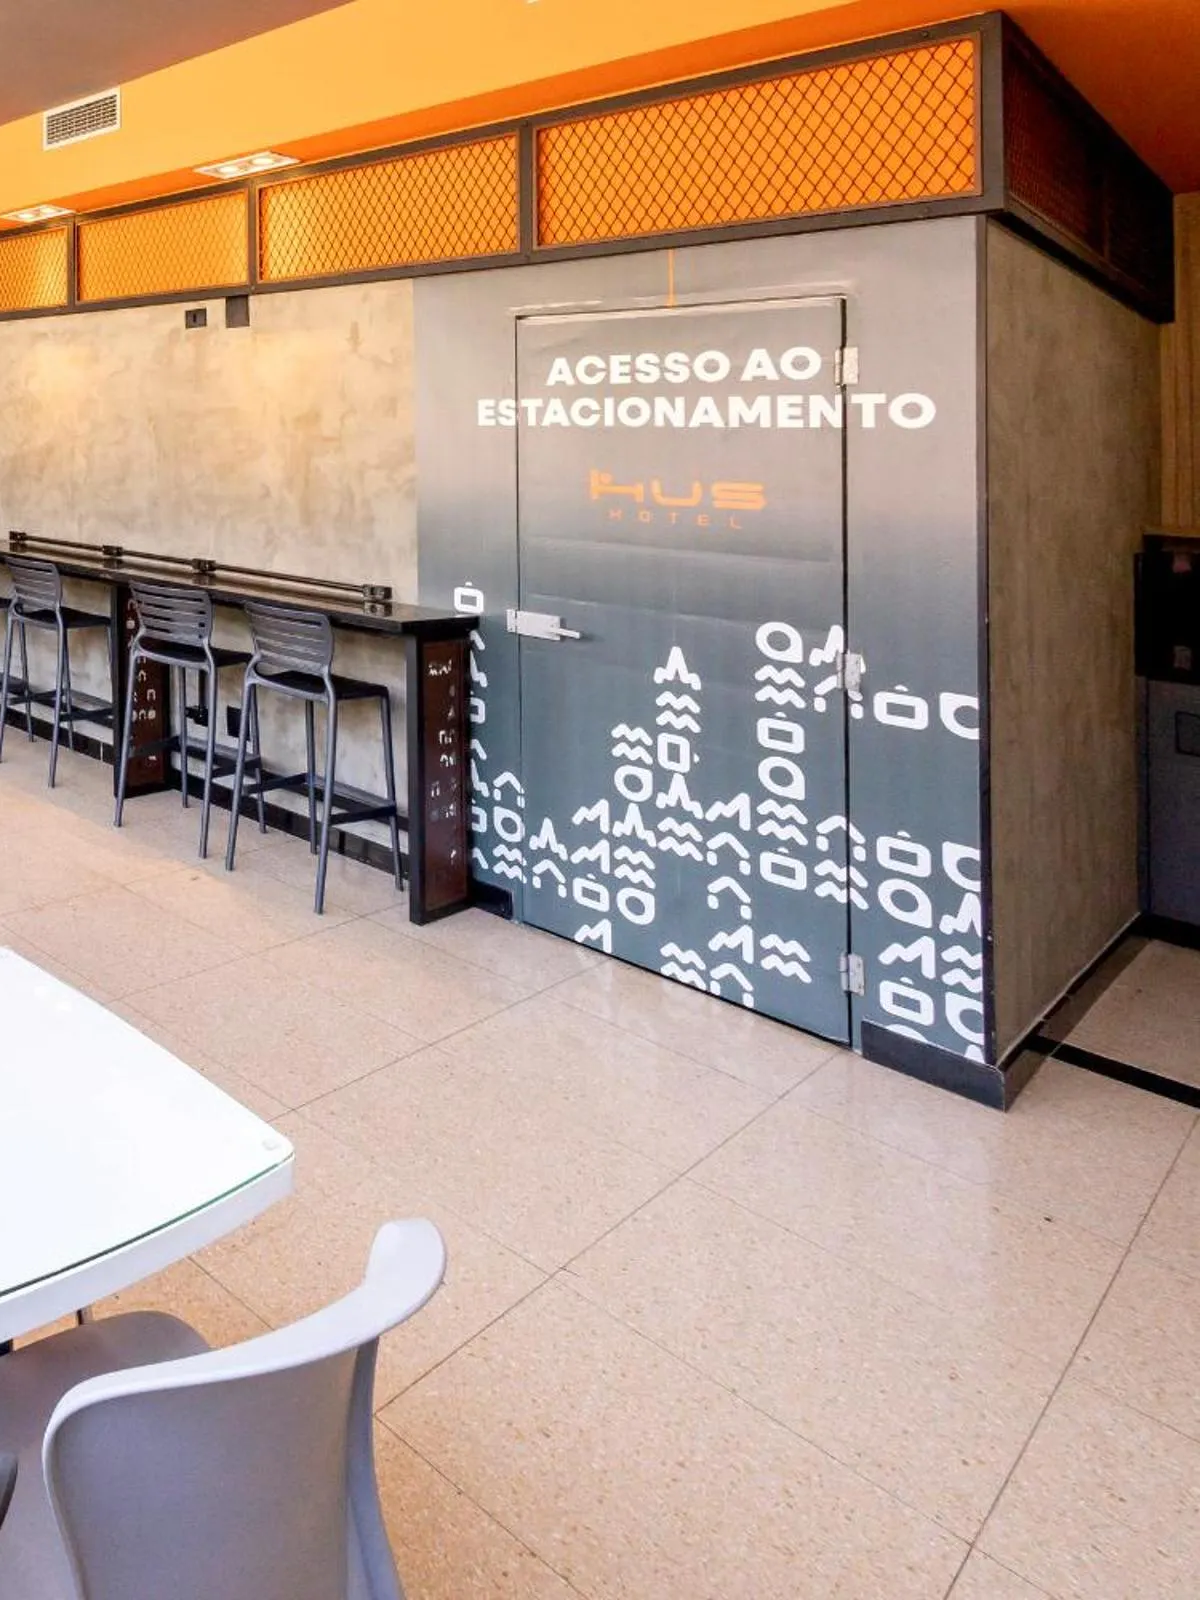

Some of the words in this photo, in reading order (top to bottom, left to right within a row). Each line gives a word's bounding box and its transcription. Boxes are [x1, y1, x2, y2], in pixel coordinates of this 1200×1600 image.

[546, 350, 730, 386] ACESSO
[740, 346, 822, 382] AO
[477, 392, 937, 429] ESTACIONAMENTO
[608, 508, 742, 529] HOTEL
